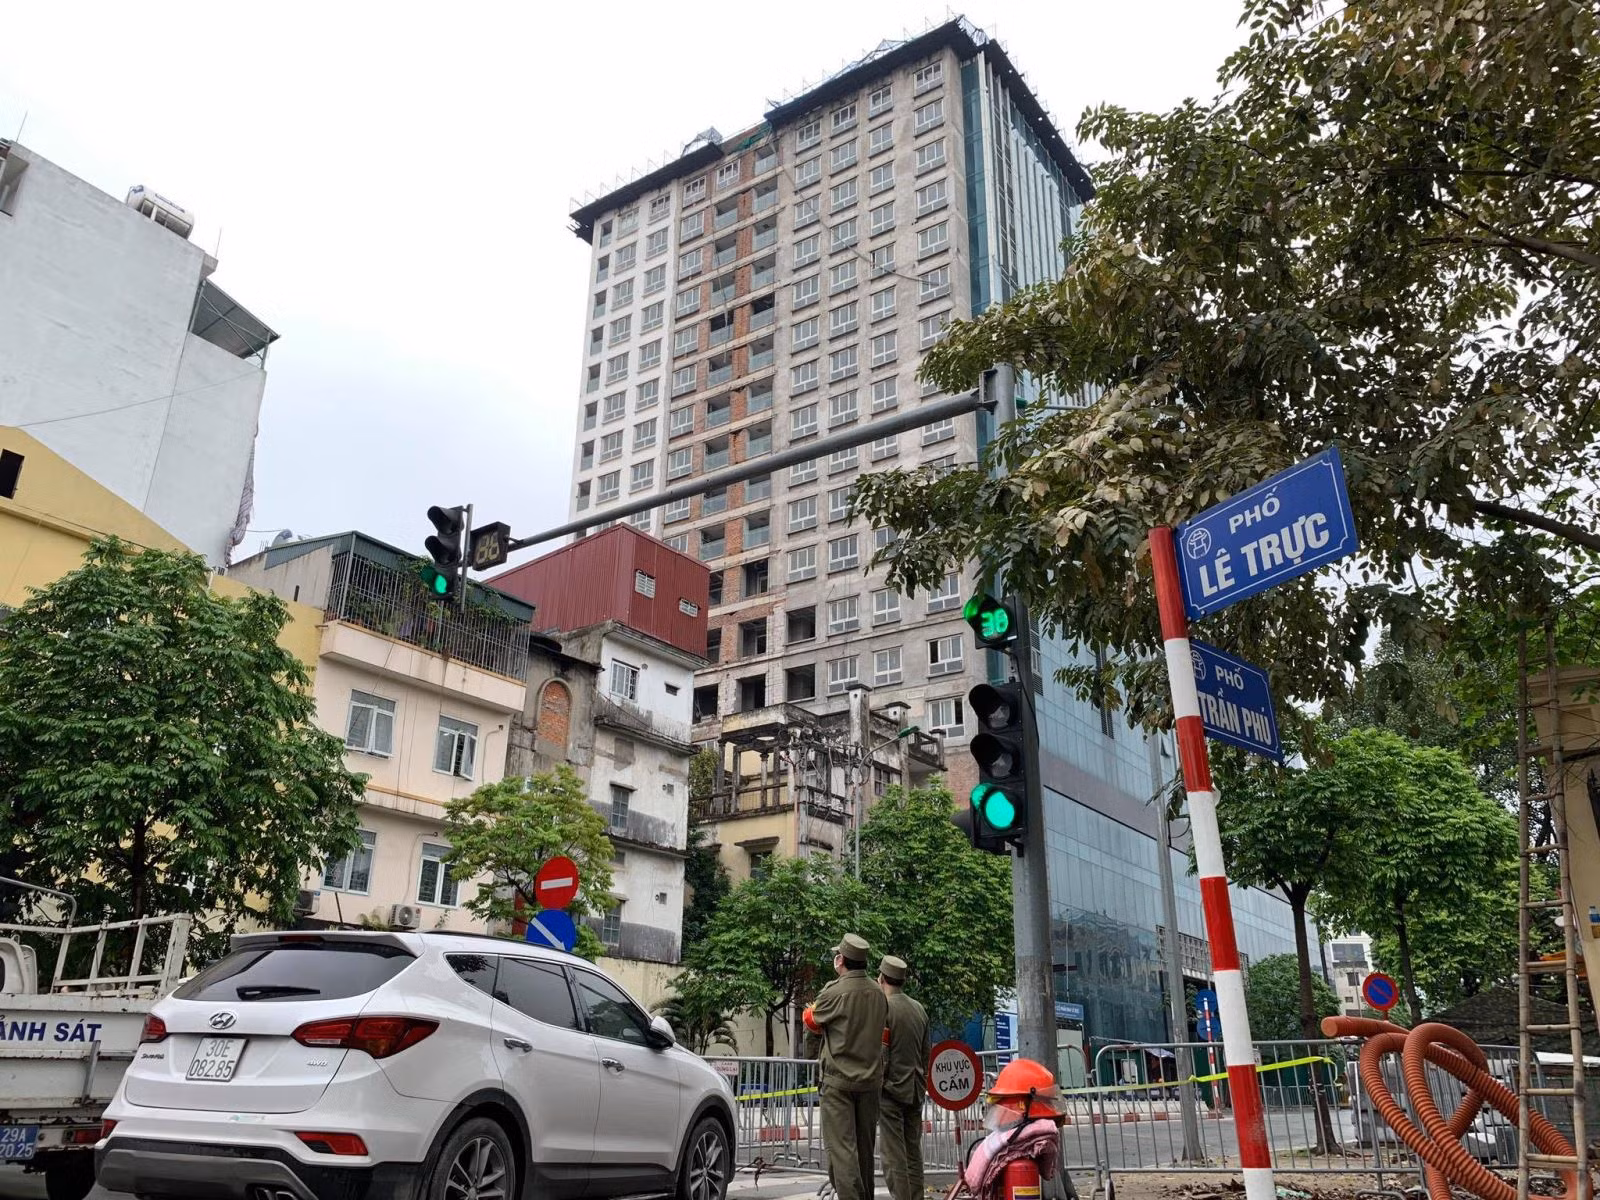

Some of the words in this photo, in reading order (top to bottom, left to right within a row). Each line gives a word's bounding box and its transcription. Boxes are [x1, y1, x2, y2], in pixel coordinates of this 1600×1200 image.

[1228, 486, 1280, 535] PHỐ
[1199, 547, 1236, 598] LÊ
[1240, 512, 1330, 577] TRỰC
[1214, 664, 1245, 691] PHỐ
[1197, 687, 1241, 735] TRẦN
[1241, 706, 1272, 746] PHÚ
[53, 1018, 102, 1042] SÁT
[206, 1040, 235, 1058] 30E
[189, 1059, 235, 1078] 082.85
[935, 1061, 952, 1073] KHU
[953, 1059, 970, 1073] VỰC
[938, 1073, 970, 1092] CẤM
[2, 1127, 27, 1142] 29A
